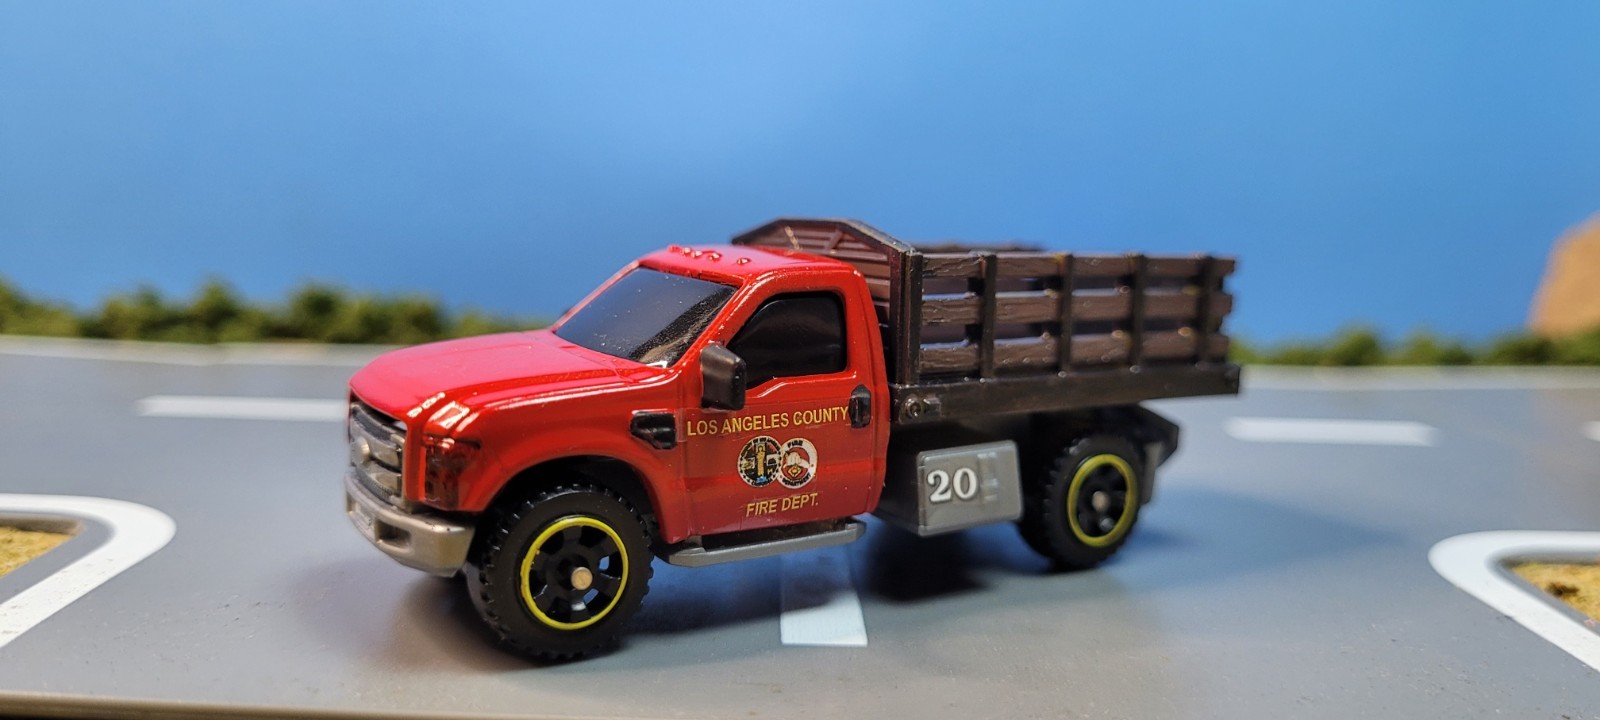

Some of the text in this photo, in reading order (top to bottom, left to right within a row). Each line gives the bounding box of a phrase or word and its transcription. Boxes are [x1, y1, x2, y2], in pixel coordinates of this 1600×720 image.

[687, 406, 849, 436] LOS ANGELES COUNTY
[927, 468, 977, 502] 20
[745, 493, 819, 517] FIRE DEPT.
